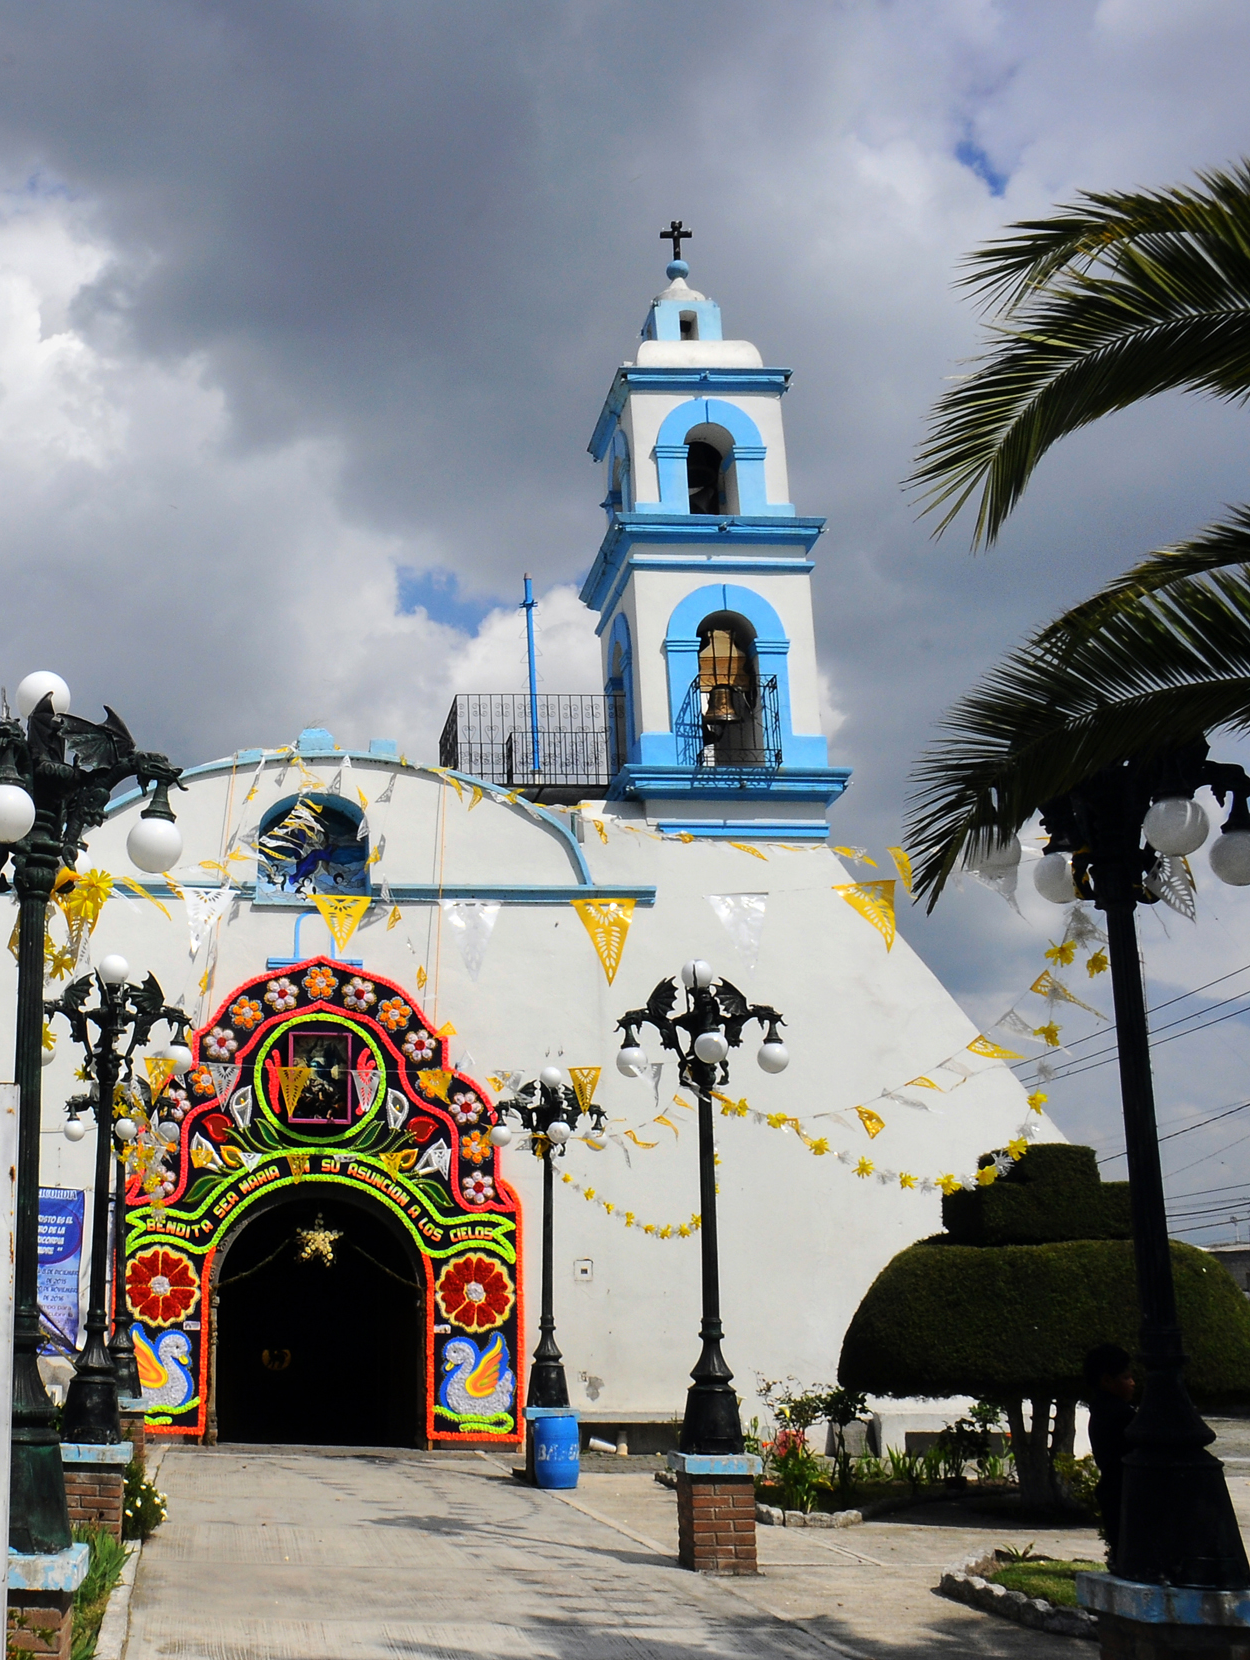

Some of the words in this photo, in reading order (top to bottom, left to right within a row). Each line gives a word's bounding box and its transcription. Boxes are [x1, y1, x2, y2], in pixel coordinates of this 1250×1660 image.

[146, 1218, 214, 1239] BENDITA
[212, 1191, 240, 1219] SEA
[238, 1165, 281, 1194] MARIA
[321, 1159, 341, 1173] SU
[347, 1162, 410, 1207] ASUNCION
[407, 1204, 422, 1219] A
[418, 1217, 444, 1242] LOS
[449, 1226, 494, 1243] CIELOS
